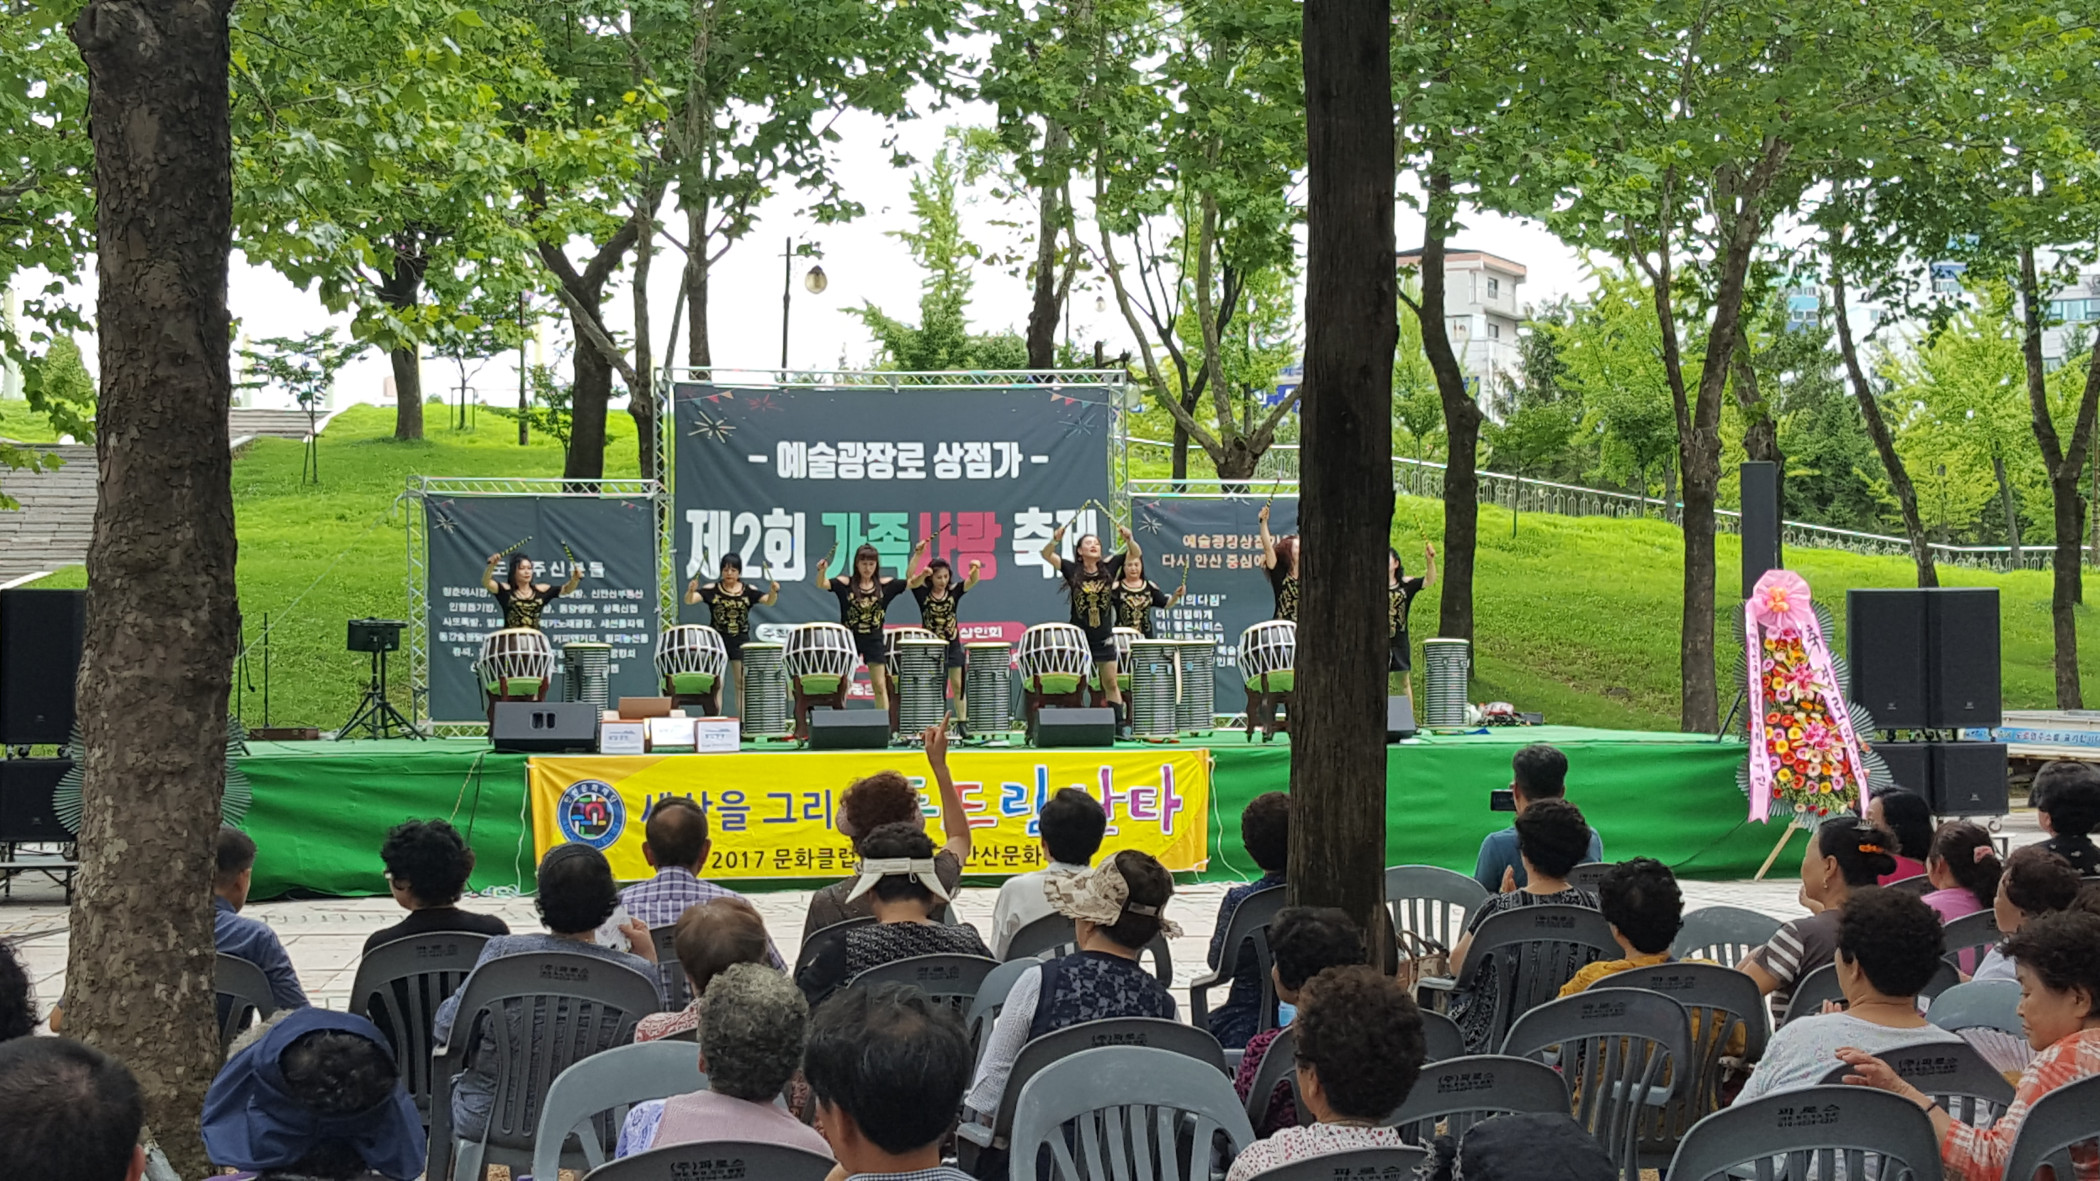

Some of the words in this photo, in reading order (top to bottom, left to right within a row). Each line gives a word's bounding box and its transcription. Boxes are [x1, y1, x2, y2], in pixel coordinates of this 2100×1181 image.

[777, 441, 926, 479] 예술광장로
[934, 442, 1023, 479] 상점가
[686, 508, 806, 581] 제2회
[821, 511, 1002, 581] 가족사랑
[1012, 507, 1098, 579] 축제
[1162, 554, 1190, 568] 다시
[1195, 554, 1222, 568] 안산
[712, 851, 764, 869] 2017
